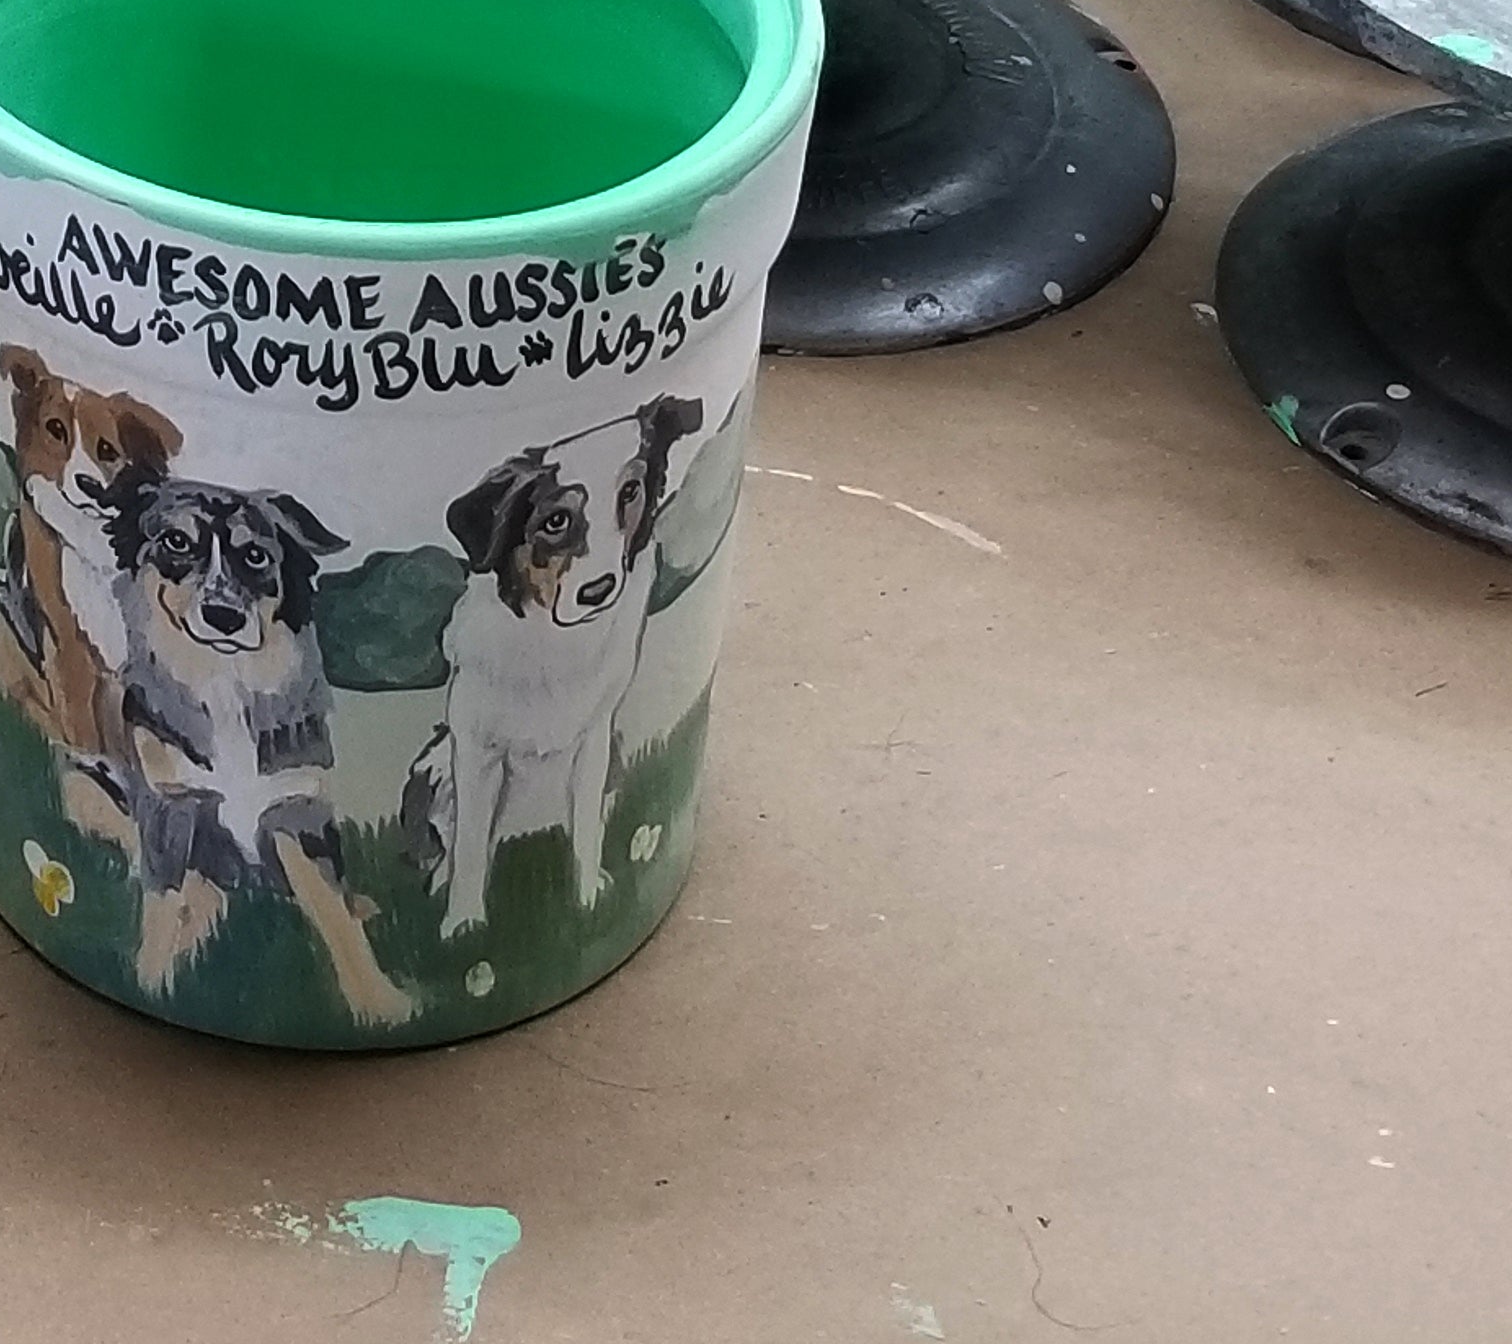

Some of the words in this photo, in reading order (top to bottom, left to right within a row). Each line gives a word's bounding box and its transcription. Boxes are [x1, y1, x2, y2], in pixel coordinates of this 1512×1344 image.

[57, 213, 385, 332] AWESOME
[409, 233, 668, 335] AUSSIES
[566, 260, 736, 380] Lizzie
